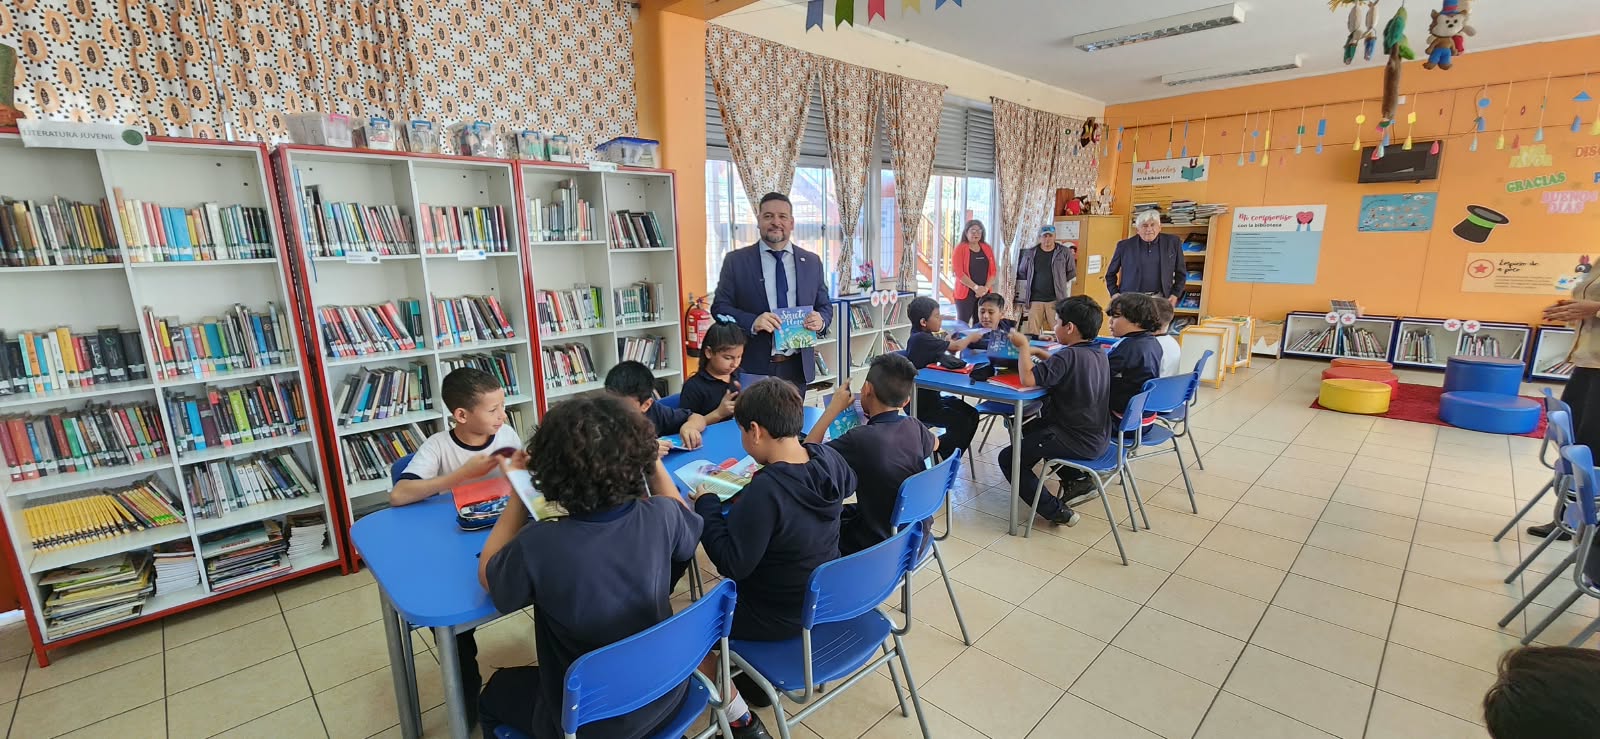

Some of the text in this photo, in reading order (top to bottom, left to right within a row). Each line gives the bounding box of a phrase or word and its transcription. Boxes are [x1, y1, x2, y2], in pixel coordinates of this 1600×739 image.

[23, 129, 115, 140] LITERATURA JUVENIL
[1506, 172, 1566, 192] GRACIAS
[1251, 214, 1293, 224] compromiso
